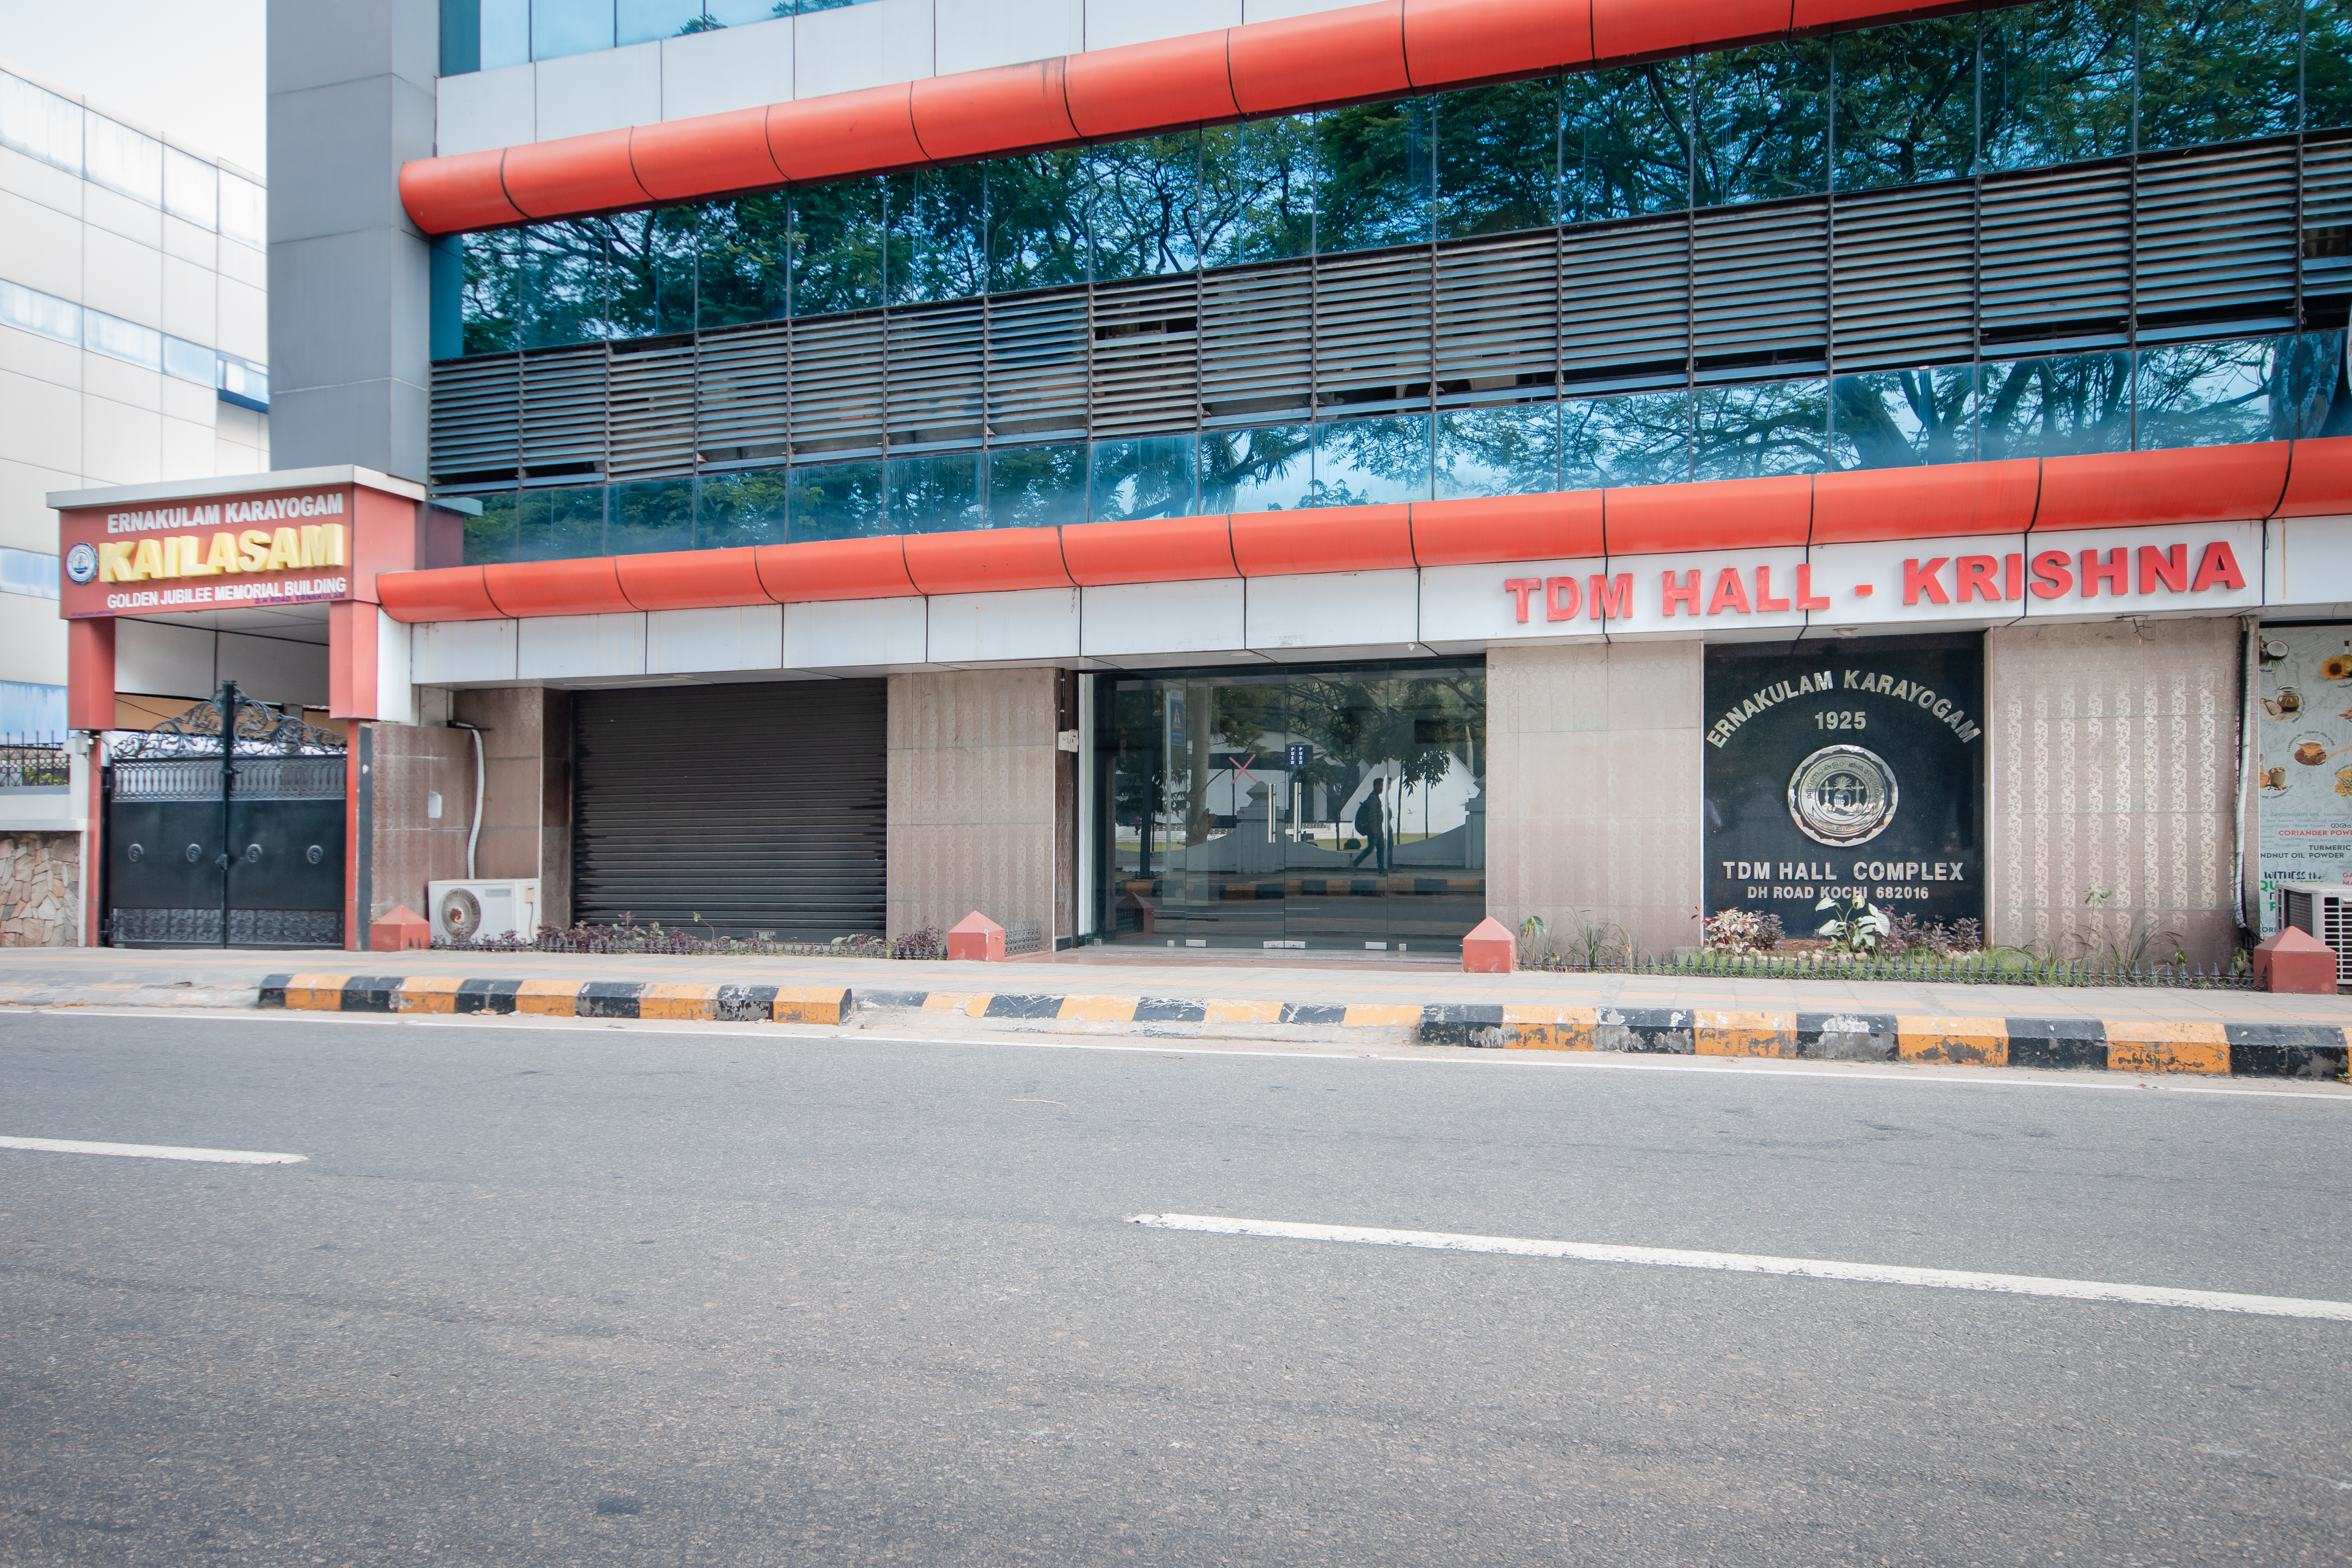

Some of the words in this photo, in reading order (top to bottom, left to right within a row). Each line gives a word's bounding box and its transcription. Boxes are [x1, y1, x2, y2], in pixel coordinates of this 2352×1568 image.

[107, 504, 220, 533] ERNAKULAM
[225, 493, 343, 524] KARAYOGAM
[98, 523, 344, 583] KAILASAM
[107, 591, 159, 609] GOLDEN
[160, 587, 213, 605] JUBILEE
[215, 582, 282, 601] MEMORIAL
[284, 577, 346, 597] BUILDING
[1504, 573, 1634, 622] TDM
[1663, 564, 1830, 616] HALL
[1903, 541, 2247, 605] KRISHNA
[1706, 671, 1834, 748] ERNAKULAM
[1844, 670, 1981, 743] KARAYOGAM
[1815, 711, 1866, 730] 1925
[1723, 861, 1770, 880] TDM
[1779, 862, 1837, 881] HALL
[1853, 862, 1964, 881] COMPLEX
[2264, 871, 2305, 879] WITNESS
[1748, 886, 1768, 899] DH
[1773, 886, 1814, 899] ROAD
[1820, 886, 1868, 899] KOCHI
[1876, 886, 1929, 899] 682016
